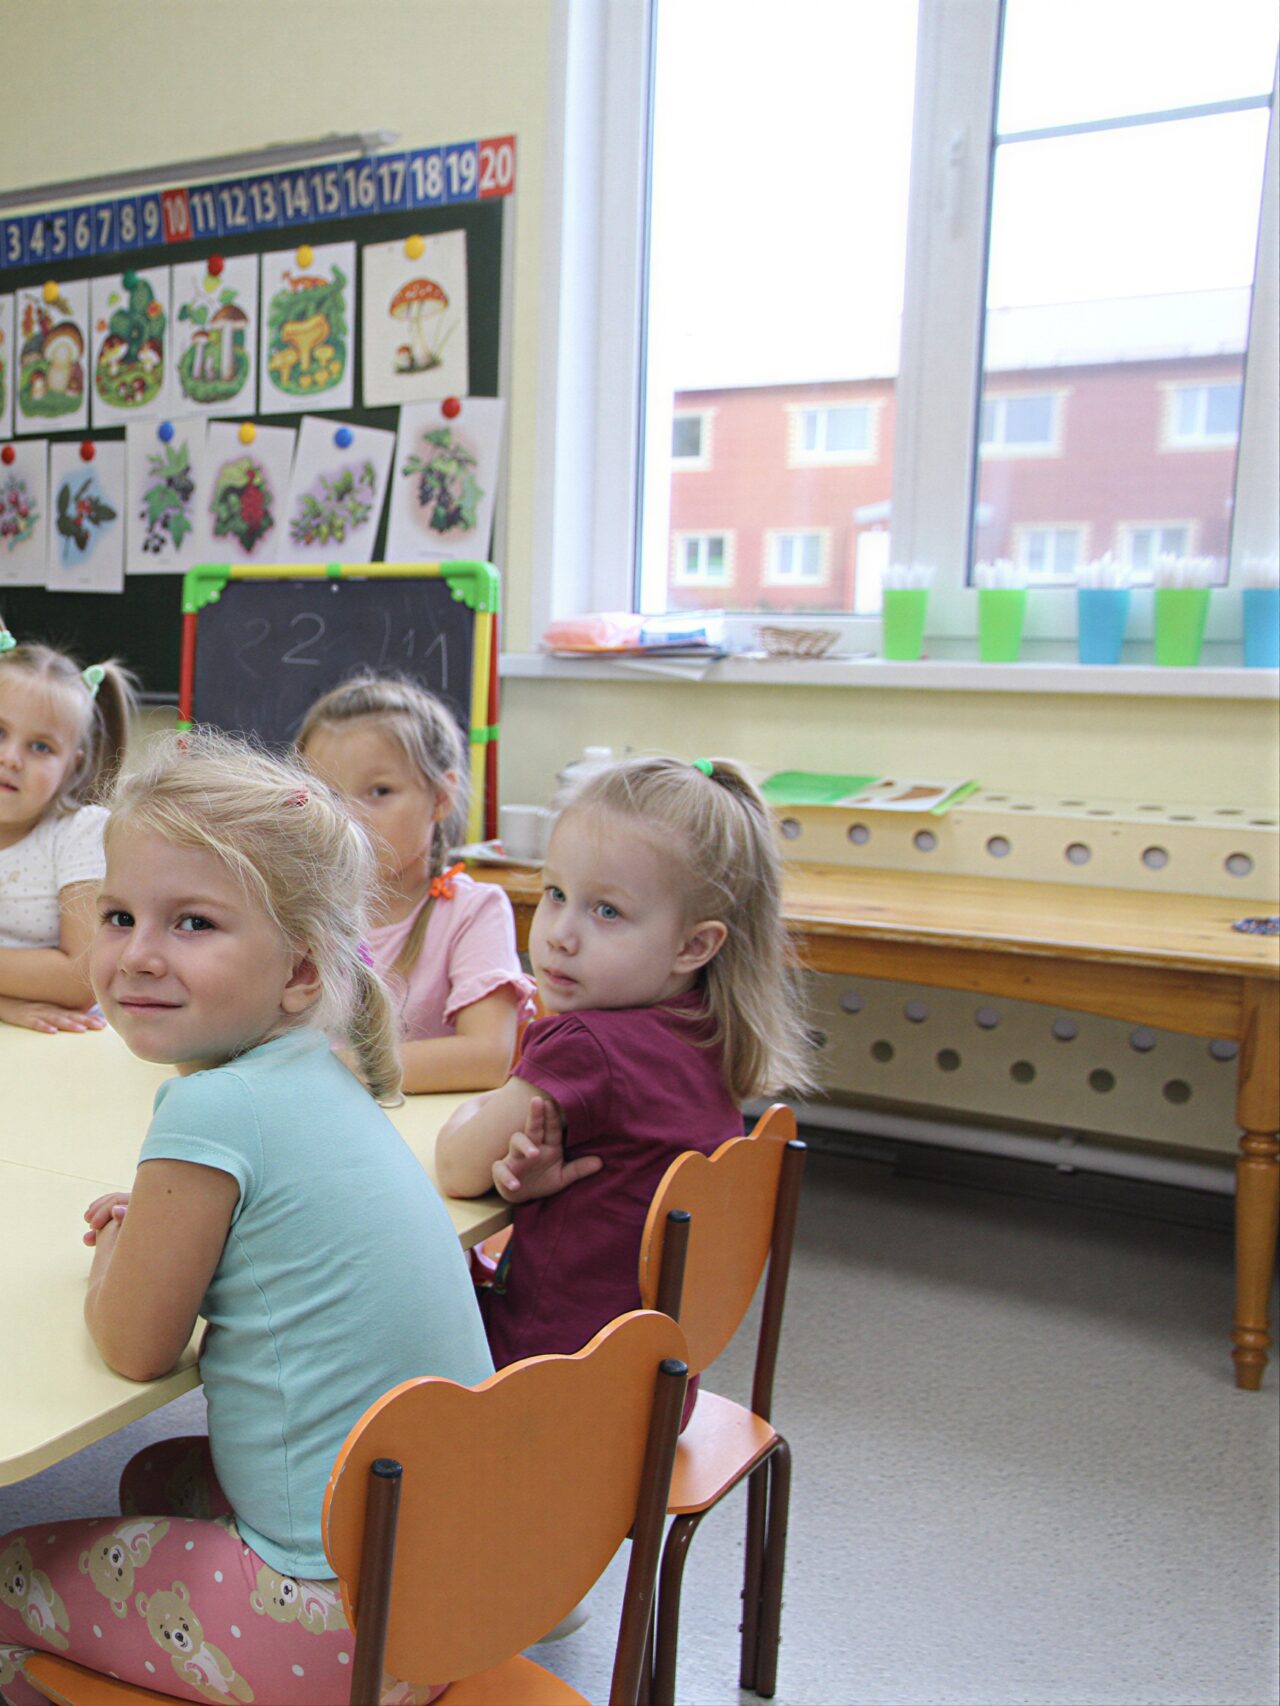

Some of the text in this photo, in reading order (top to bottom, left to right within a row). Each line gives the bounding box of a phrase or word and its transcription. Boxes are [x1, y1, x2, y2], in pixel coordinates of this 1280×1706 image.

[7, 224, 21, 261] 3
[30, 220, 45, 255] 4
[52, 217, 66, 254] 5
[74, 213, 90, 250] 6
[97, 208, 112, 247] 7
[120, 204, 136, 242] 8
[143, 200, 159, 239] 9
[166, 197, 187, 236] 10
[191, 192, 215, 231] 11
[220, 187, 247, 227] 12
[249, 182, 277, 221] 13
[279, 176, 309, 219] 14
[310, 171, 340, 214] 15
[345, 165, 374, 208] 16
[377, 159, 407, 204] 17
[411, 153, 442, 200] 18
[446, 149, 476, 195] 19
[480, 144, 512, 190] 20
[281, 612, 325, 665] 2
